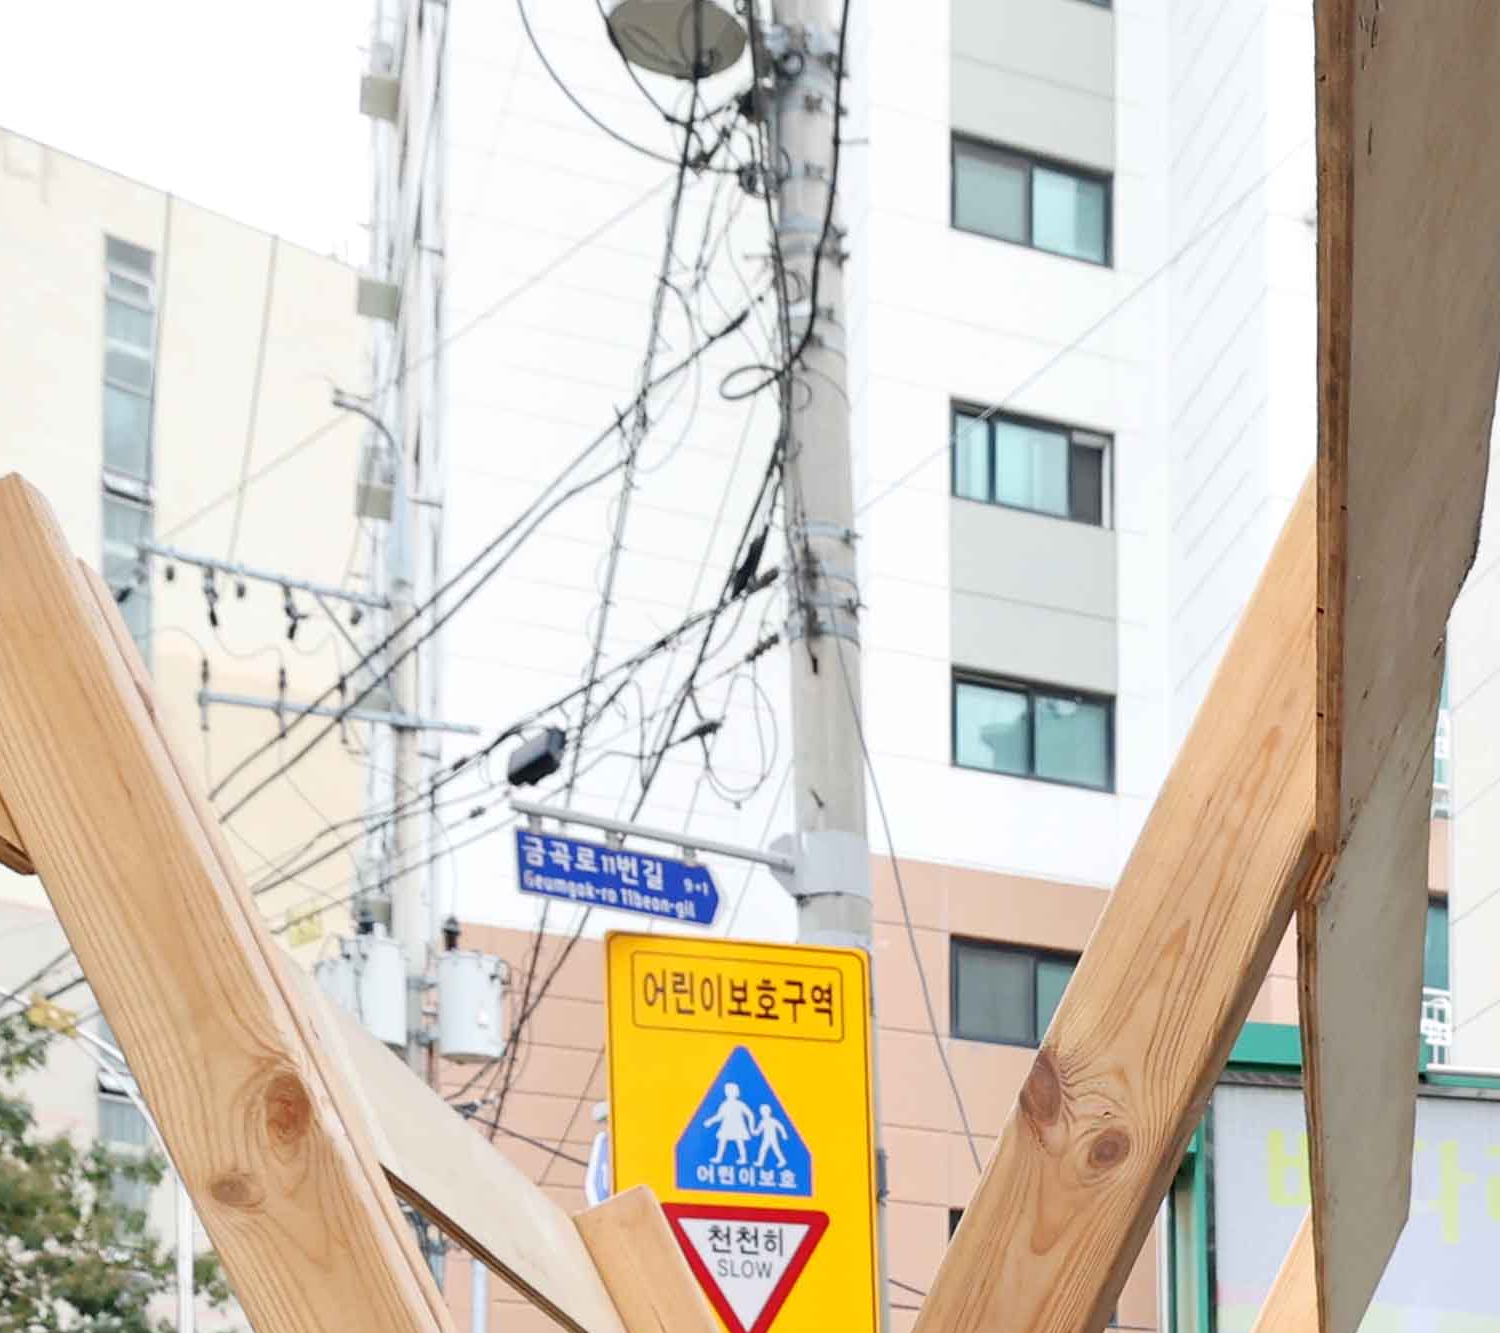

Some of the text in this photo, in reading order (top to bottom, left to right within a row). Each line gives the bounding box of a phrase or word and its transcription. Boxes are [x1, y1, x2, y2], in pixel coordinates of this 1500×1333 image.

[643, 969, 836, 1027] 어린이보호구역
[696, 1165, 798, 1190] 어린이보호
[708, 1224, 786, 1257] 천천히
[716, 1259, 775, 1281] SLOW
